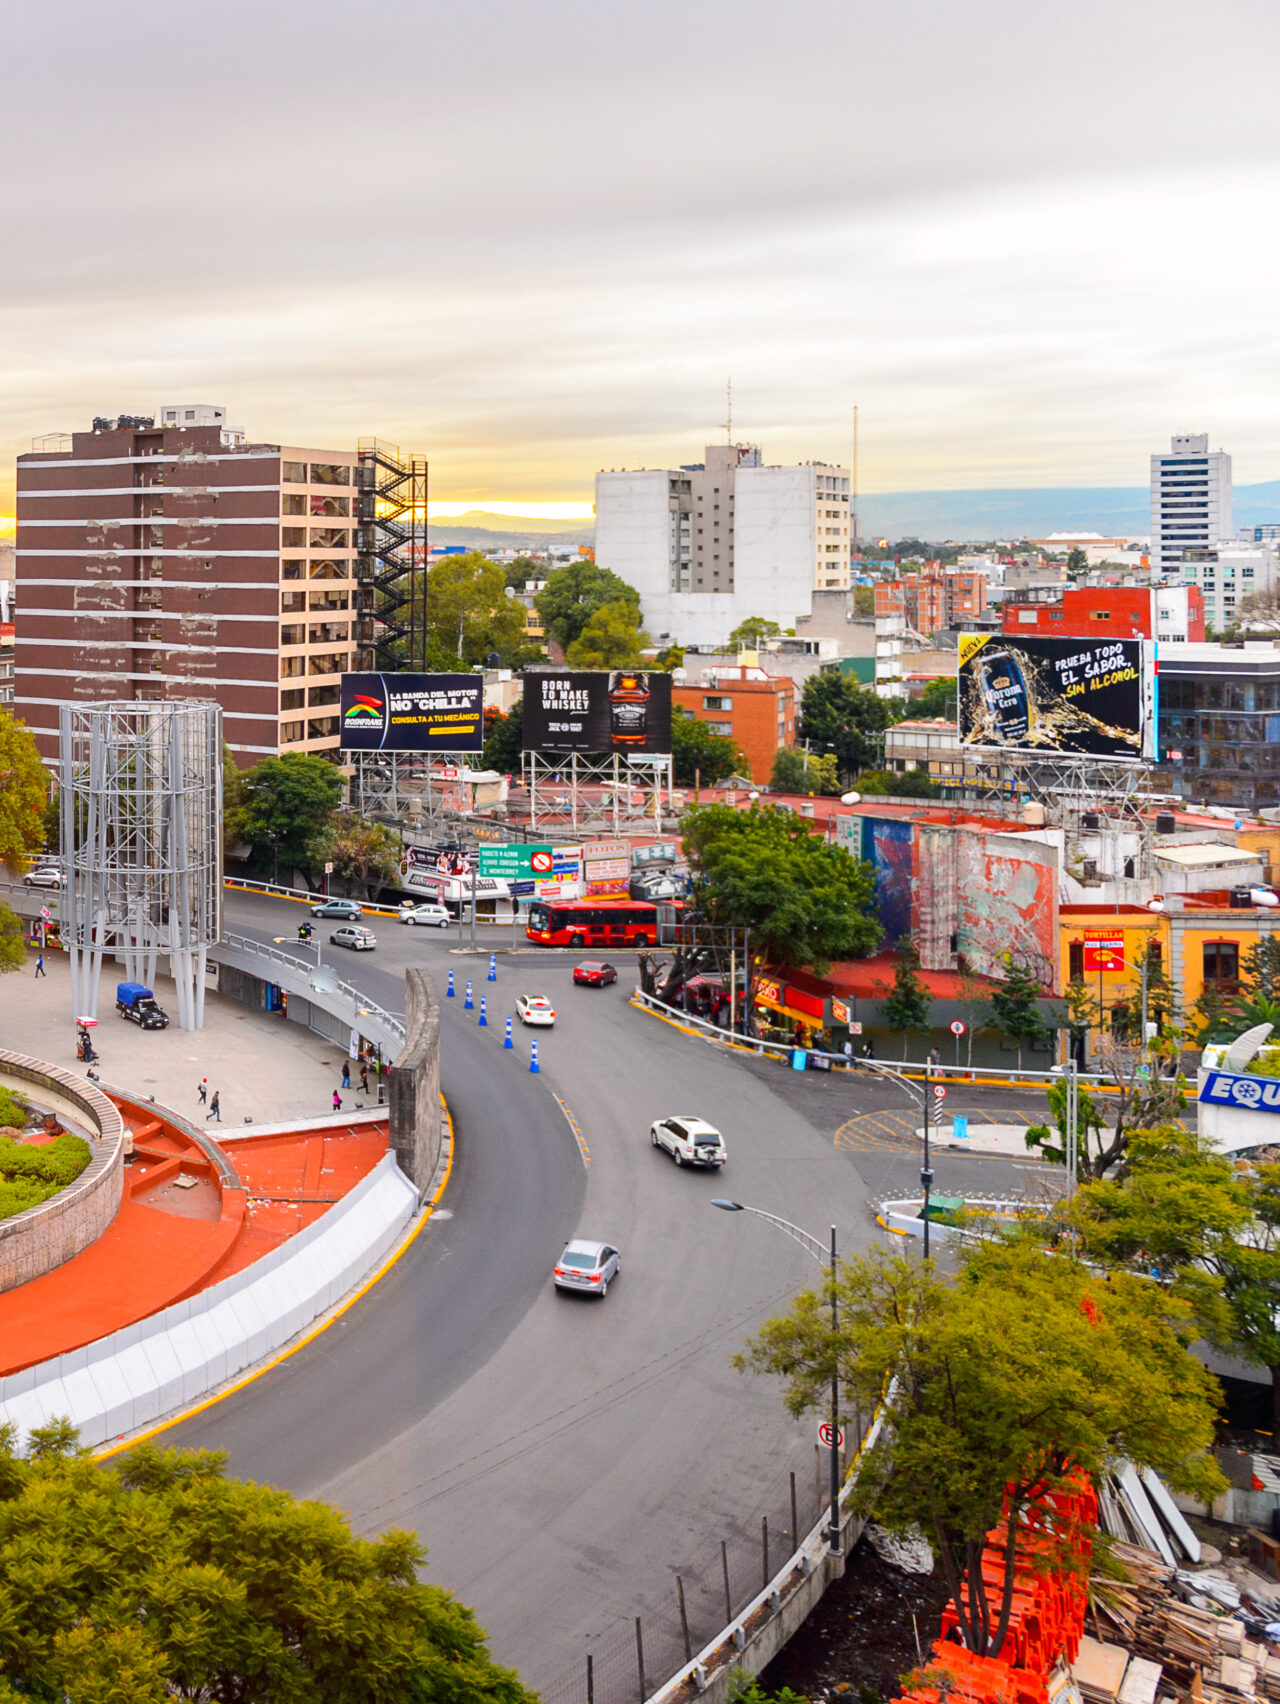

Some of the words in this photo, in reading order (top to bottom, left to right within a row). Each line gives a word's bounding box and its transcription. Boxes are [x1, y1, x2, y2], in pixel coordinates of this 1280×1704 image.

[960, 637, 982, 659] NUEVA
[1055, 652, 1092, 671] PRUEBA
[1095, 643, 1123, 660] TODO
[1061, 670, 1079, 685] EL
[1066, 682, 1085, 697] SIN
[1090, 667, 1139, 691] ALCOHOL
[542, 680, 571, 690] BORN
[402, 691, 430, 700] BANDA
[430, 690, 447, 699] DEL
[447, 689, 478, 697] MOTOR
[542, 690, 555, 700] TO
[560, 690, 589, 700] MAKE
[985, 684, 1023, 703] Corona
[390, 700, 412, 712] NO
[542, 700, 589, 710] WHISKEY
[999, 698, 1018, 708] Cero
[391, 715, 427, 724] CONSULTA
[427, 714, 433, 722] A
[434, 714, 443, 722] TU
